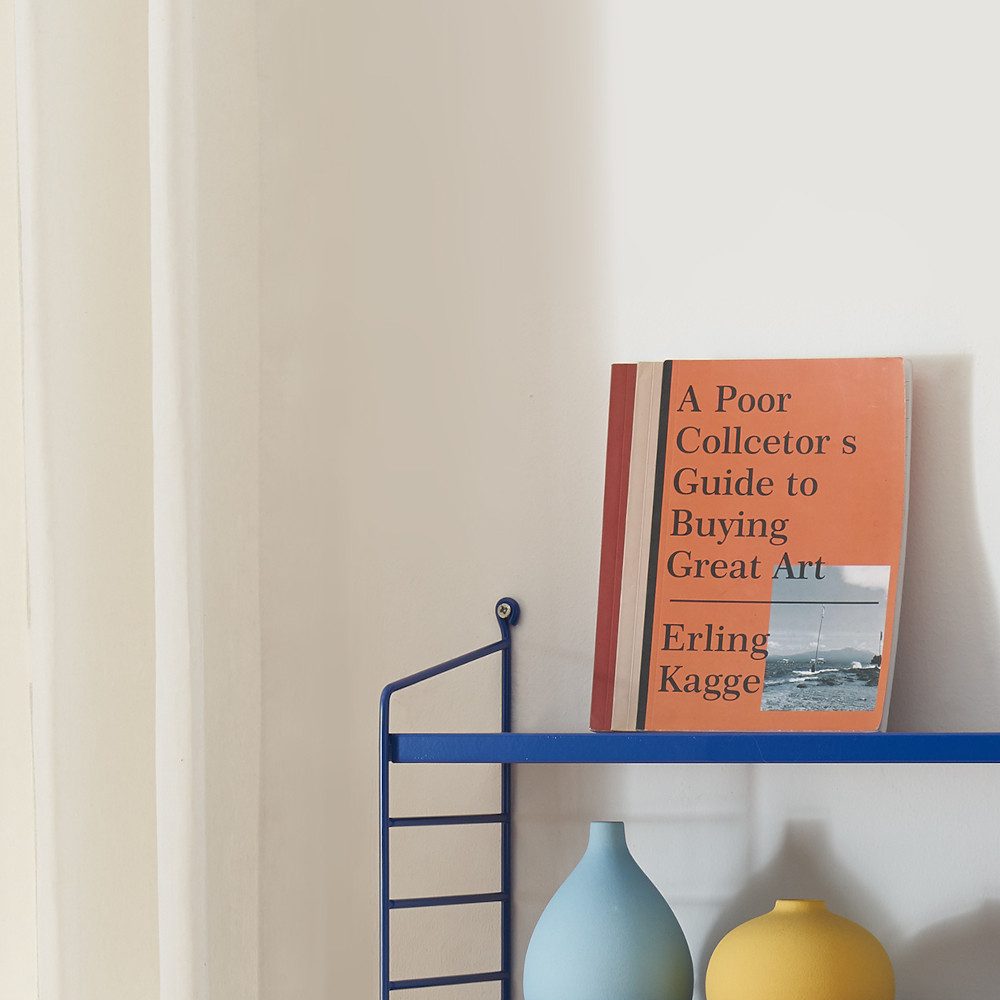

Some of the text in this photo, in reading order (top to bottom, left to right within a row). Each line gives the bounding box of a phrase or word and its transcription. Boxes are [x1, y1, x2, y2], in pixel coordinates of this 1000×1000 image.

[677, 385, 792, 413] A Poor
[676, 426, 831, 454] Collcetor
[673, 468, 818, 496] Guide to
[670, 509, 789, 546] Buying
[667, 550, 826, 580] Great Art
[661, 623, 770, 661] Erling
[658, 665, 760, 701] Kagge
